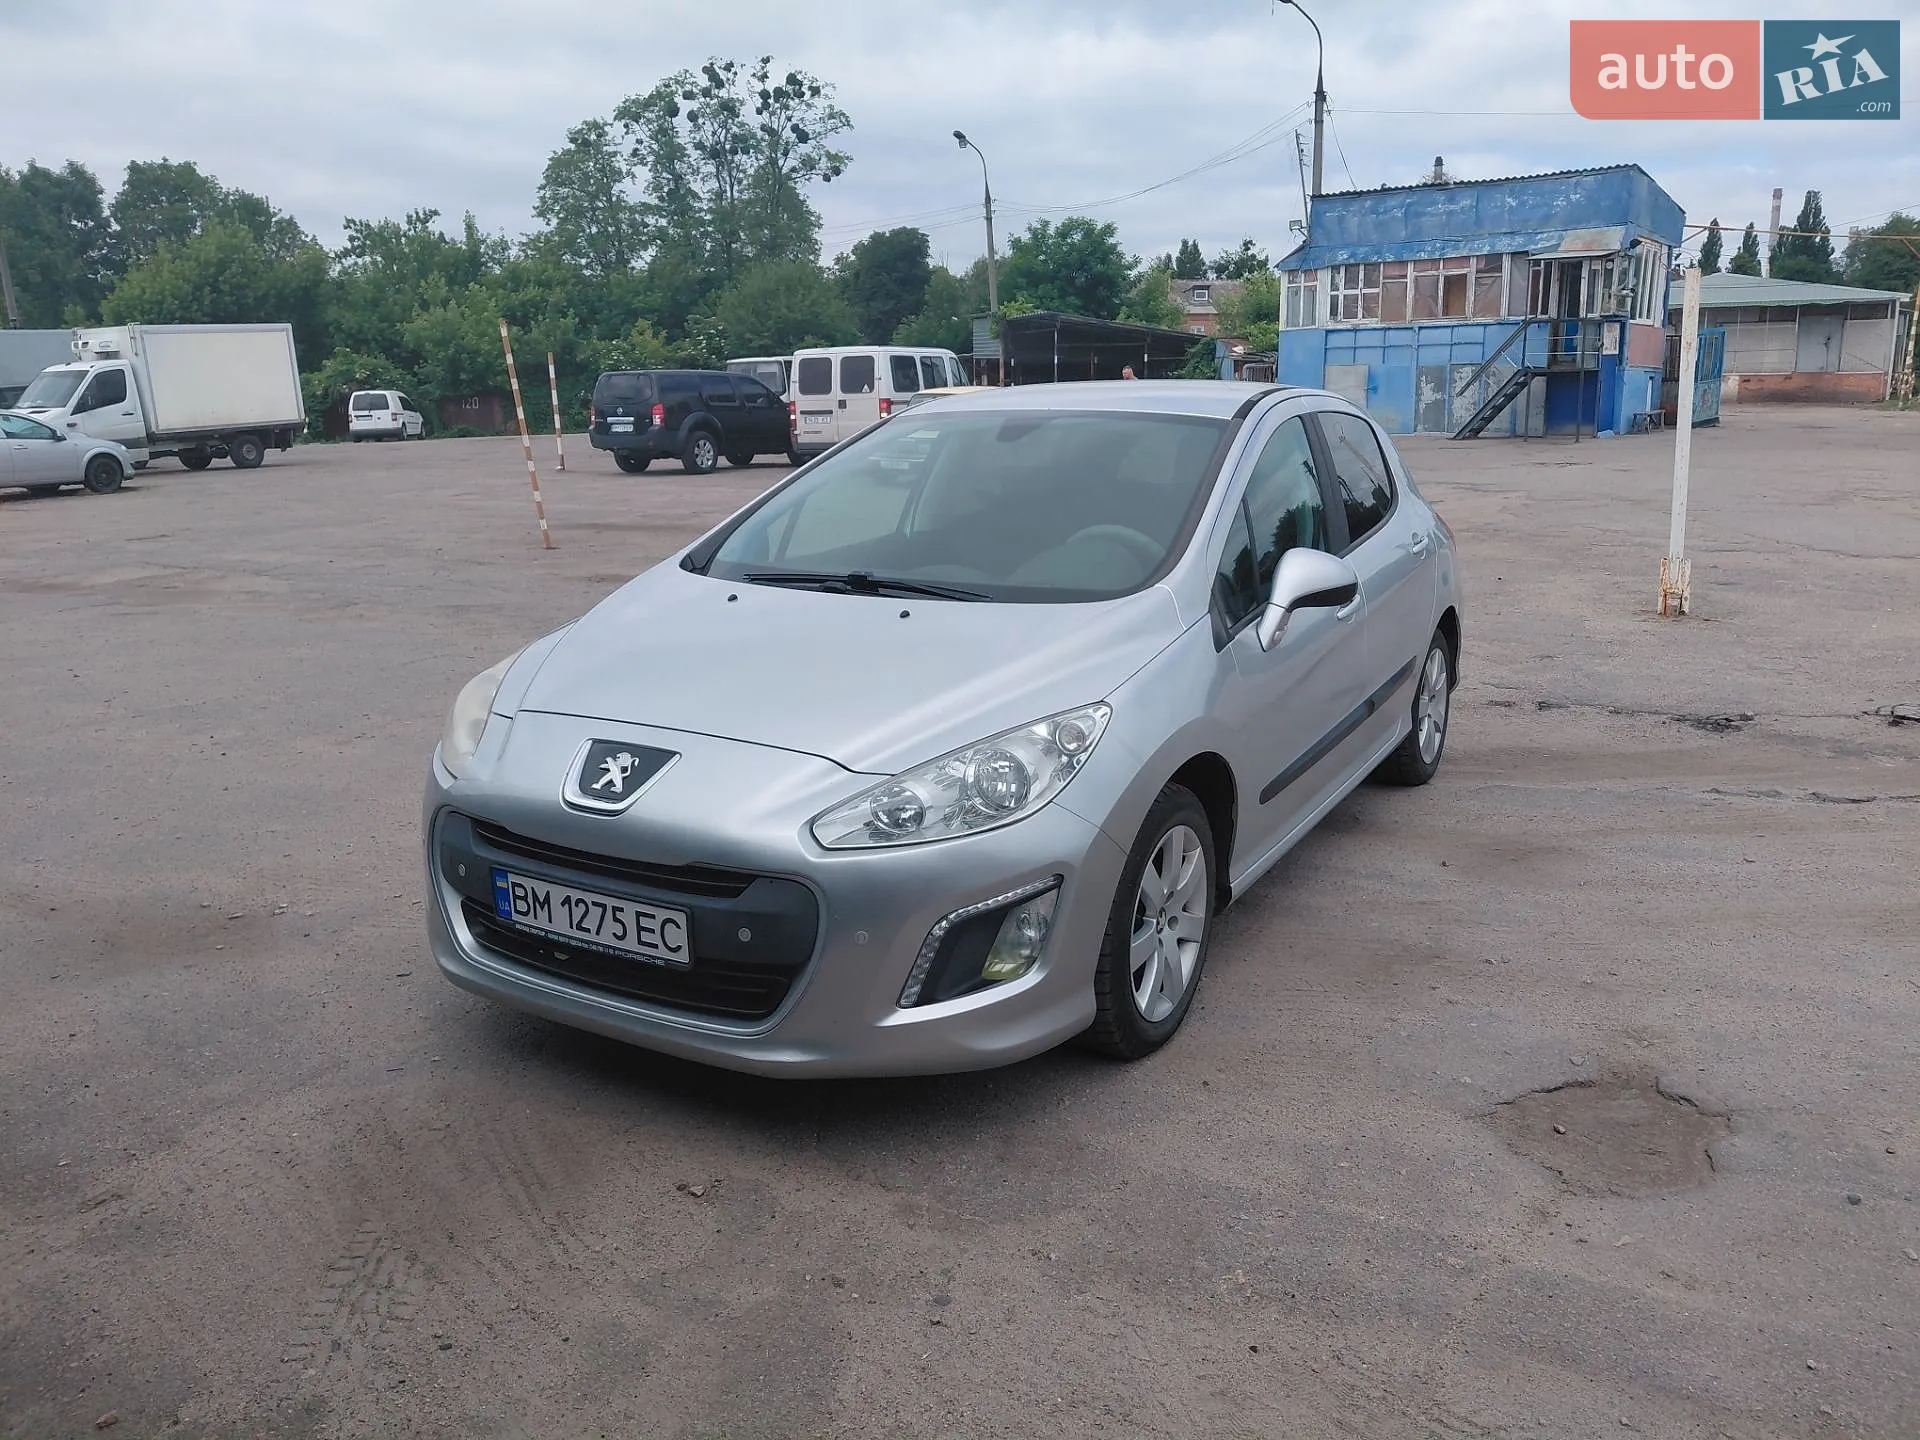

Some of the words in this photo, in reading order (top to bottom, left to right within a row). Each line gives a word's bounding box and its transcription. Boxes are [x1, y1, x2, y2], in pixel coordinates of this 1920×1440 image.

[498, 898, 511, 913] UA
[510, 880, 553, 924] BM
[560, 894, 628, 941] 1275
[635, 910, 682, 953] EC
